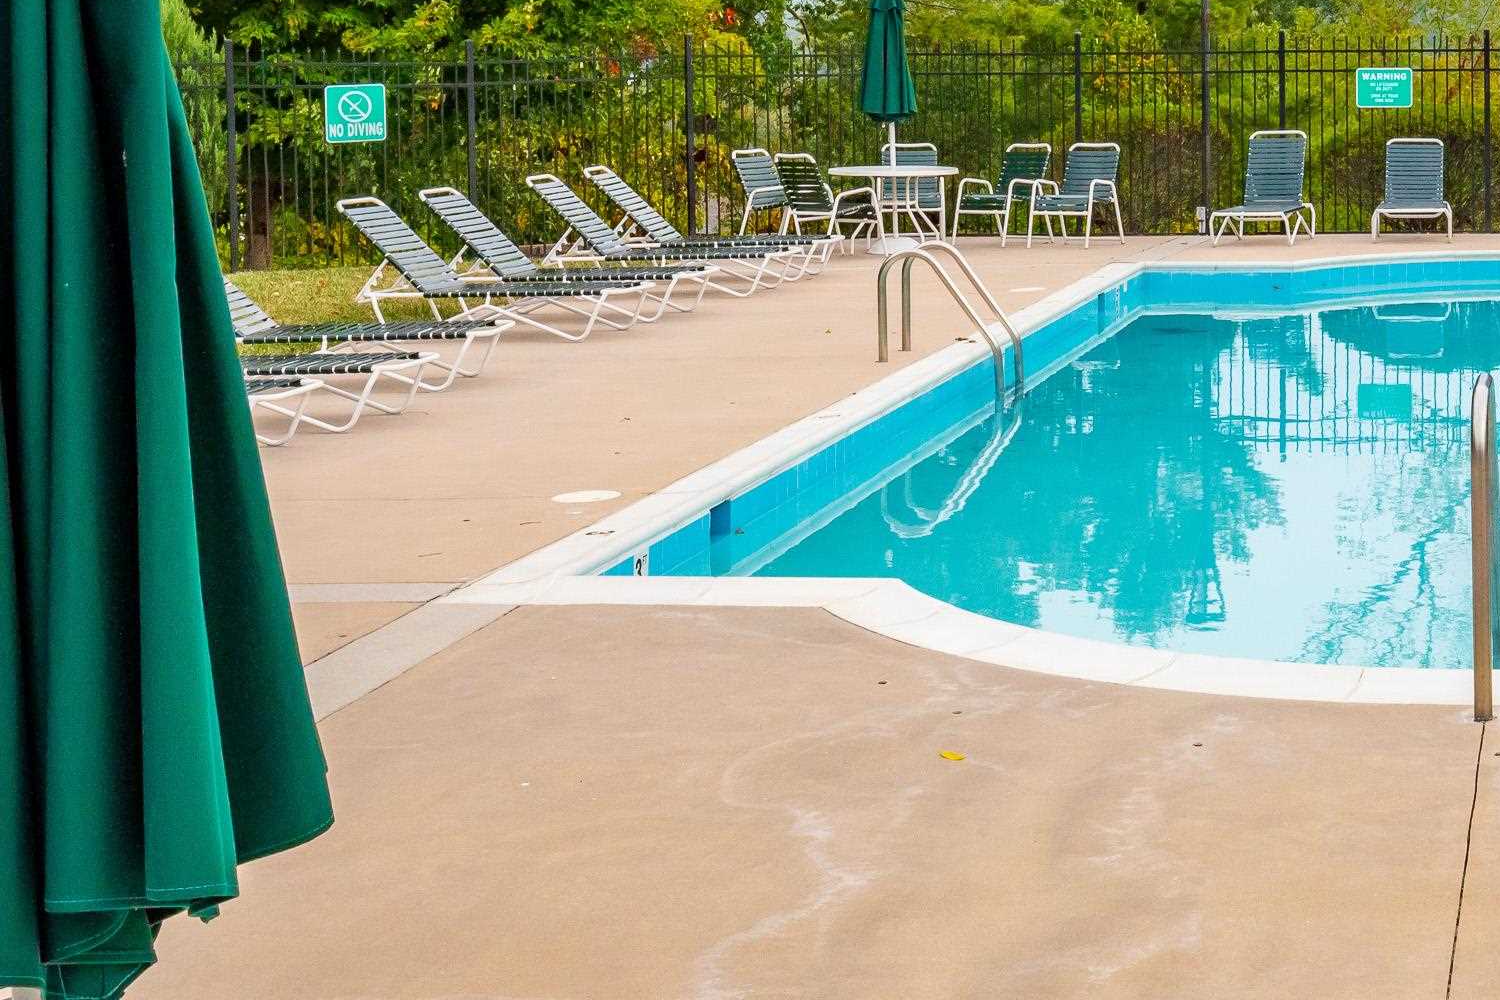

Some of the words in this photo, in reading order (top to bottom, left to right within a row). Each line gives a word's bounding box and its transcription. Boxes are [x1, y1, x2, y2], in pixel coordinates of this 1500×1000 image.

[1361, 72, 1407, 81] WARNING
[329, 123, 344, 138] NO
[347, 121, 383, 137] DIVING
